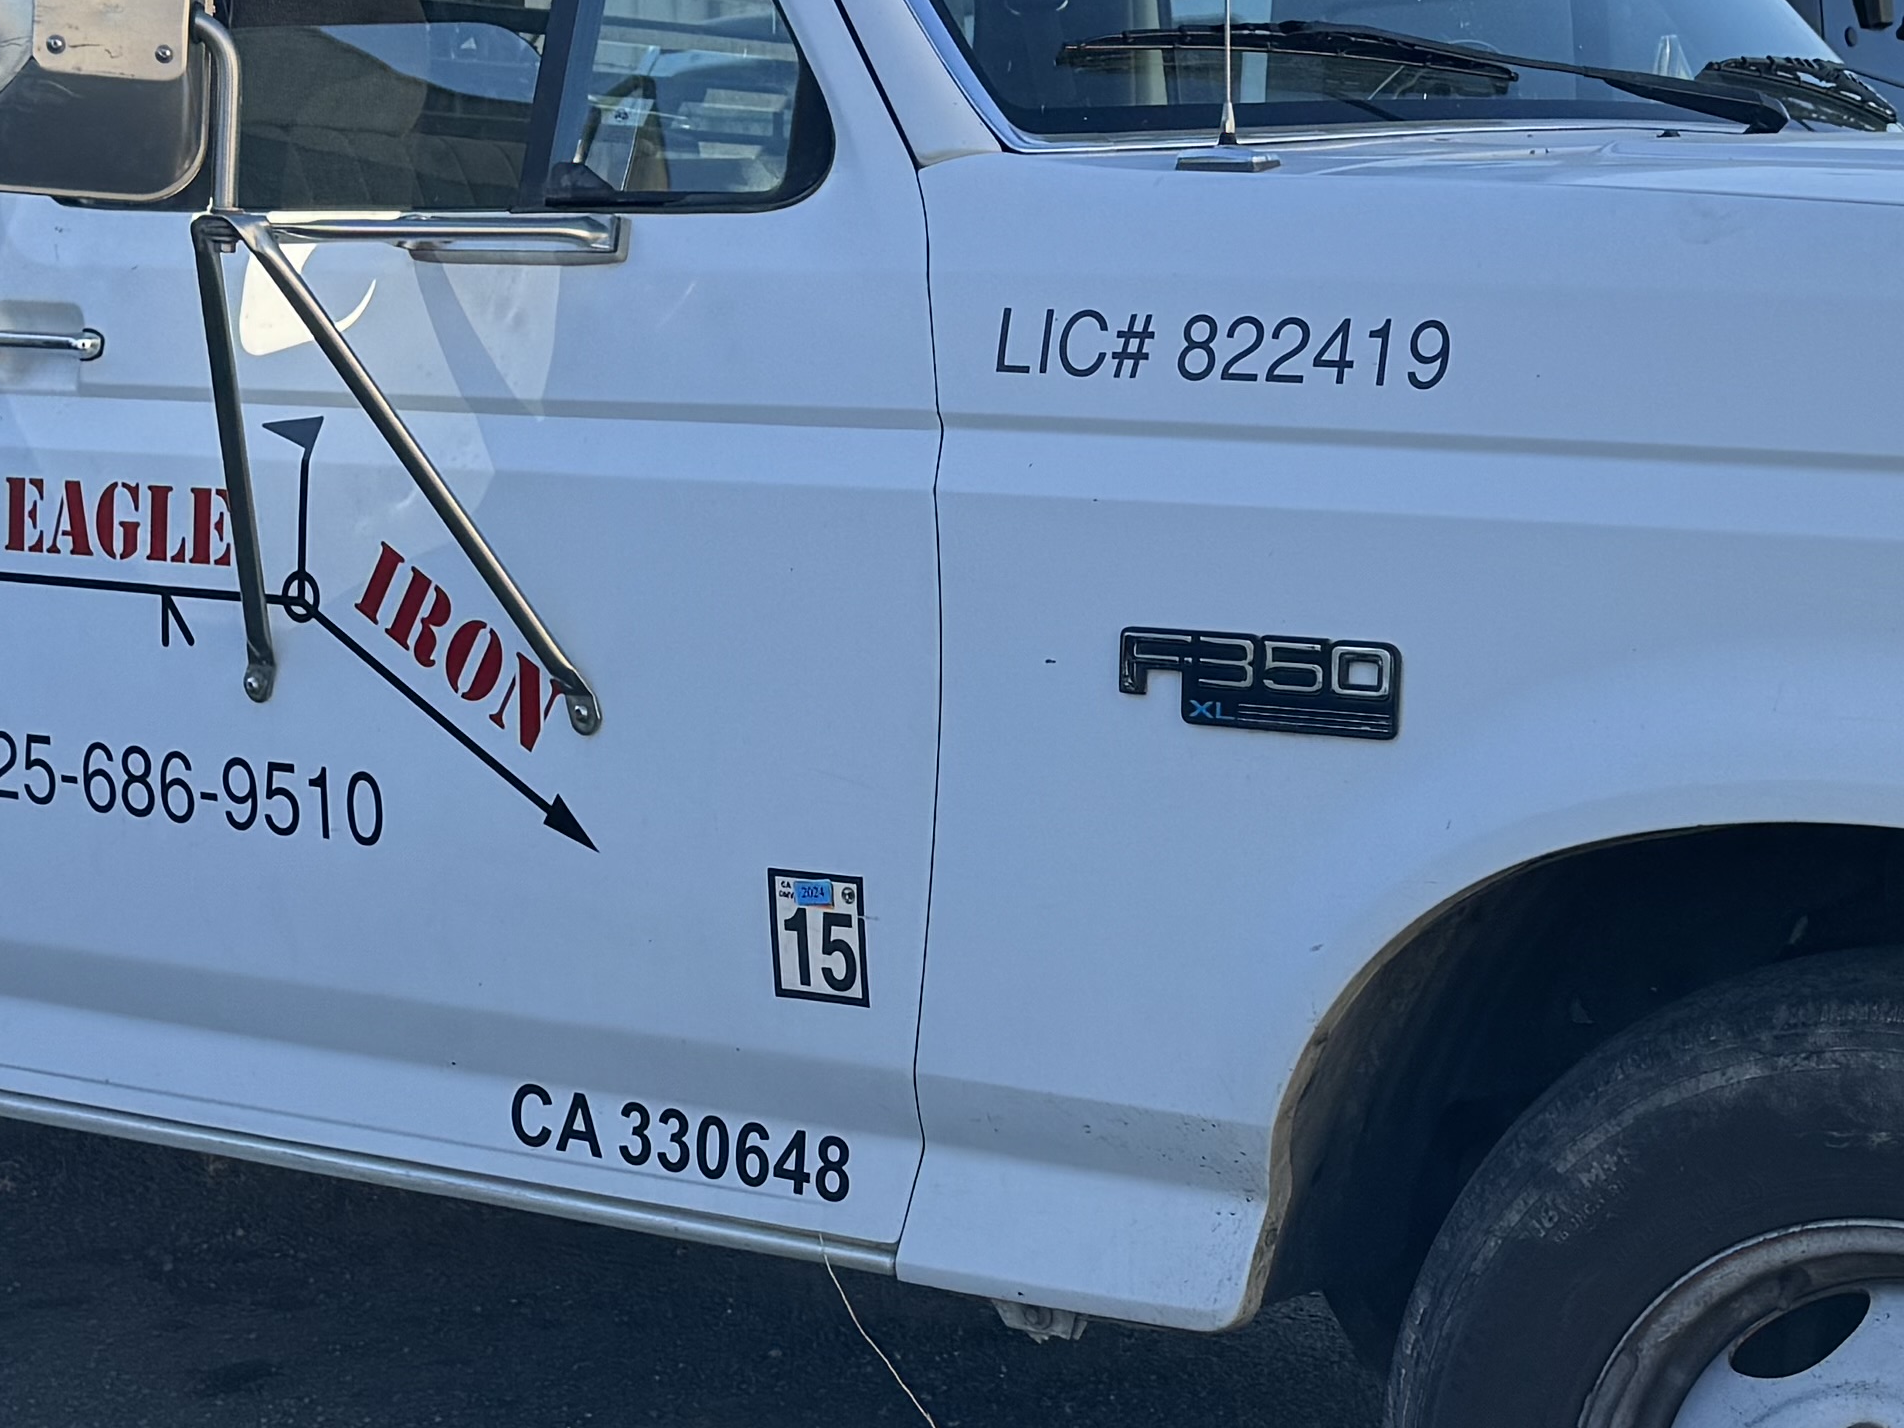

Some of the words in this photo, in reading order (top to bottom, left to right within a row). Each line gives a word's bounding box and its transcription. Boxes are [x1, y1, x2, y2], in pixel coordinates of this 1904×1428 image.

[996, 307, 1156, 379] LIC#
[1177, 314, 1451, 390] 822419
[4, 476, 232, 567] EAGLE
[354, 540, 566, 753] IRON
[1188, 699, 1236, 721] XL
[800, 886, 825, 900] 2024
[783, 907, 857, 992] 15
[511, 1083, 603, 1159] CA
[618, 1101, 850, 1203] 330648
